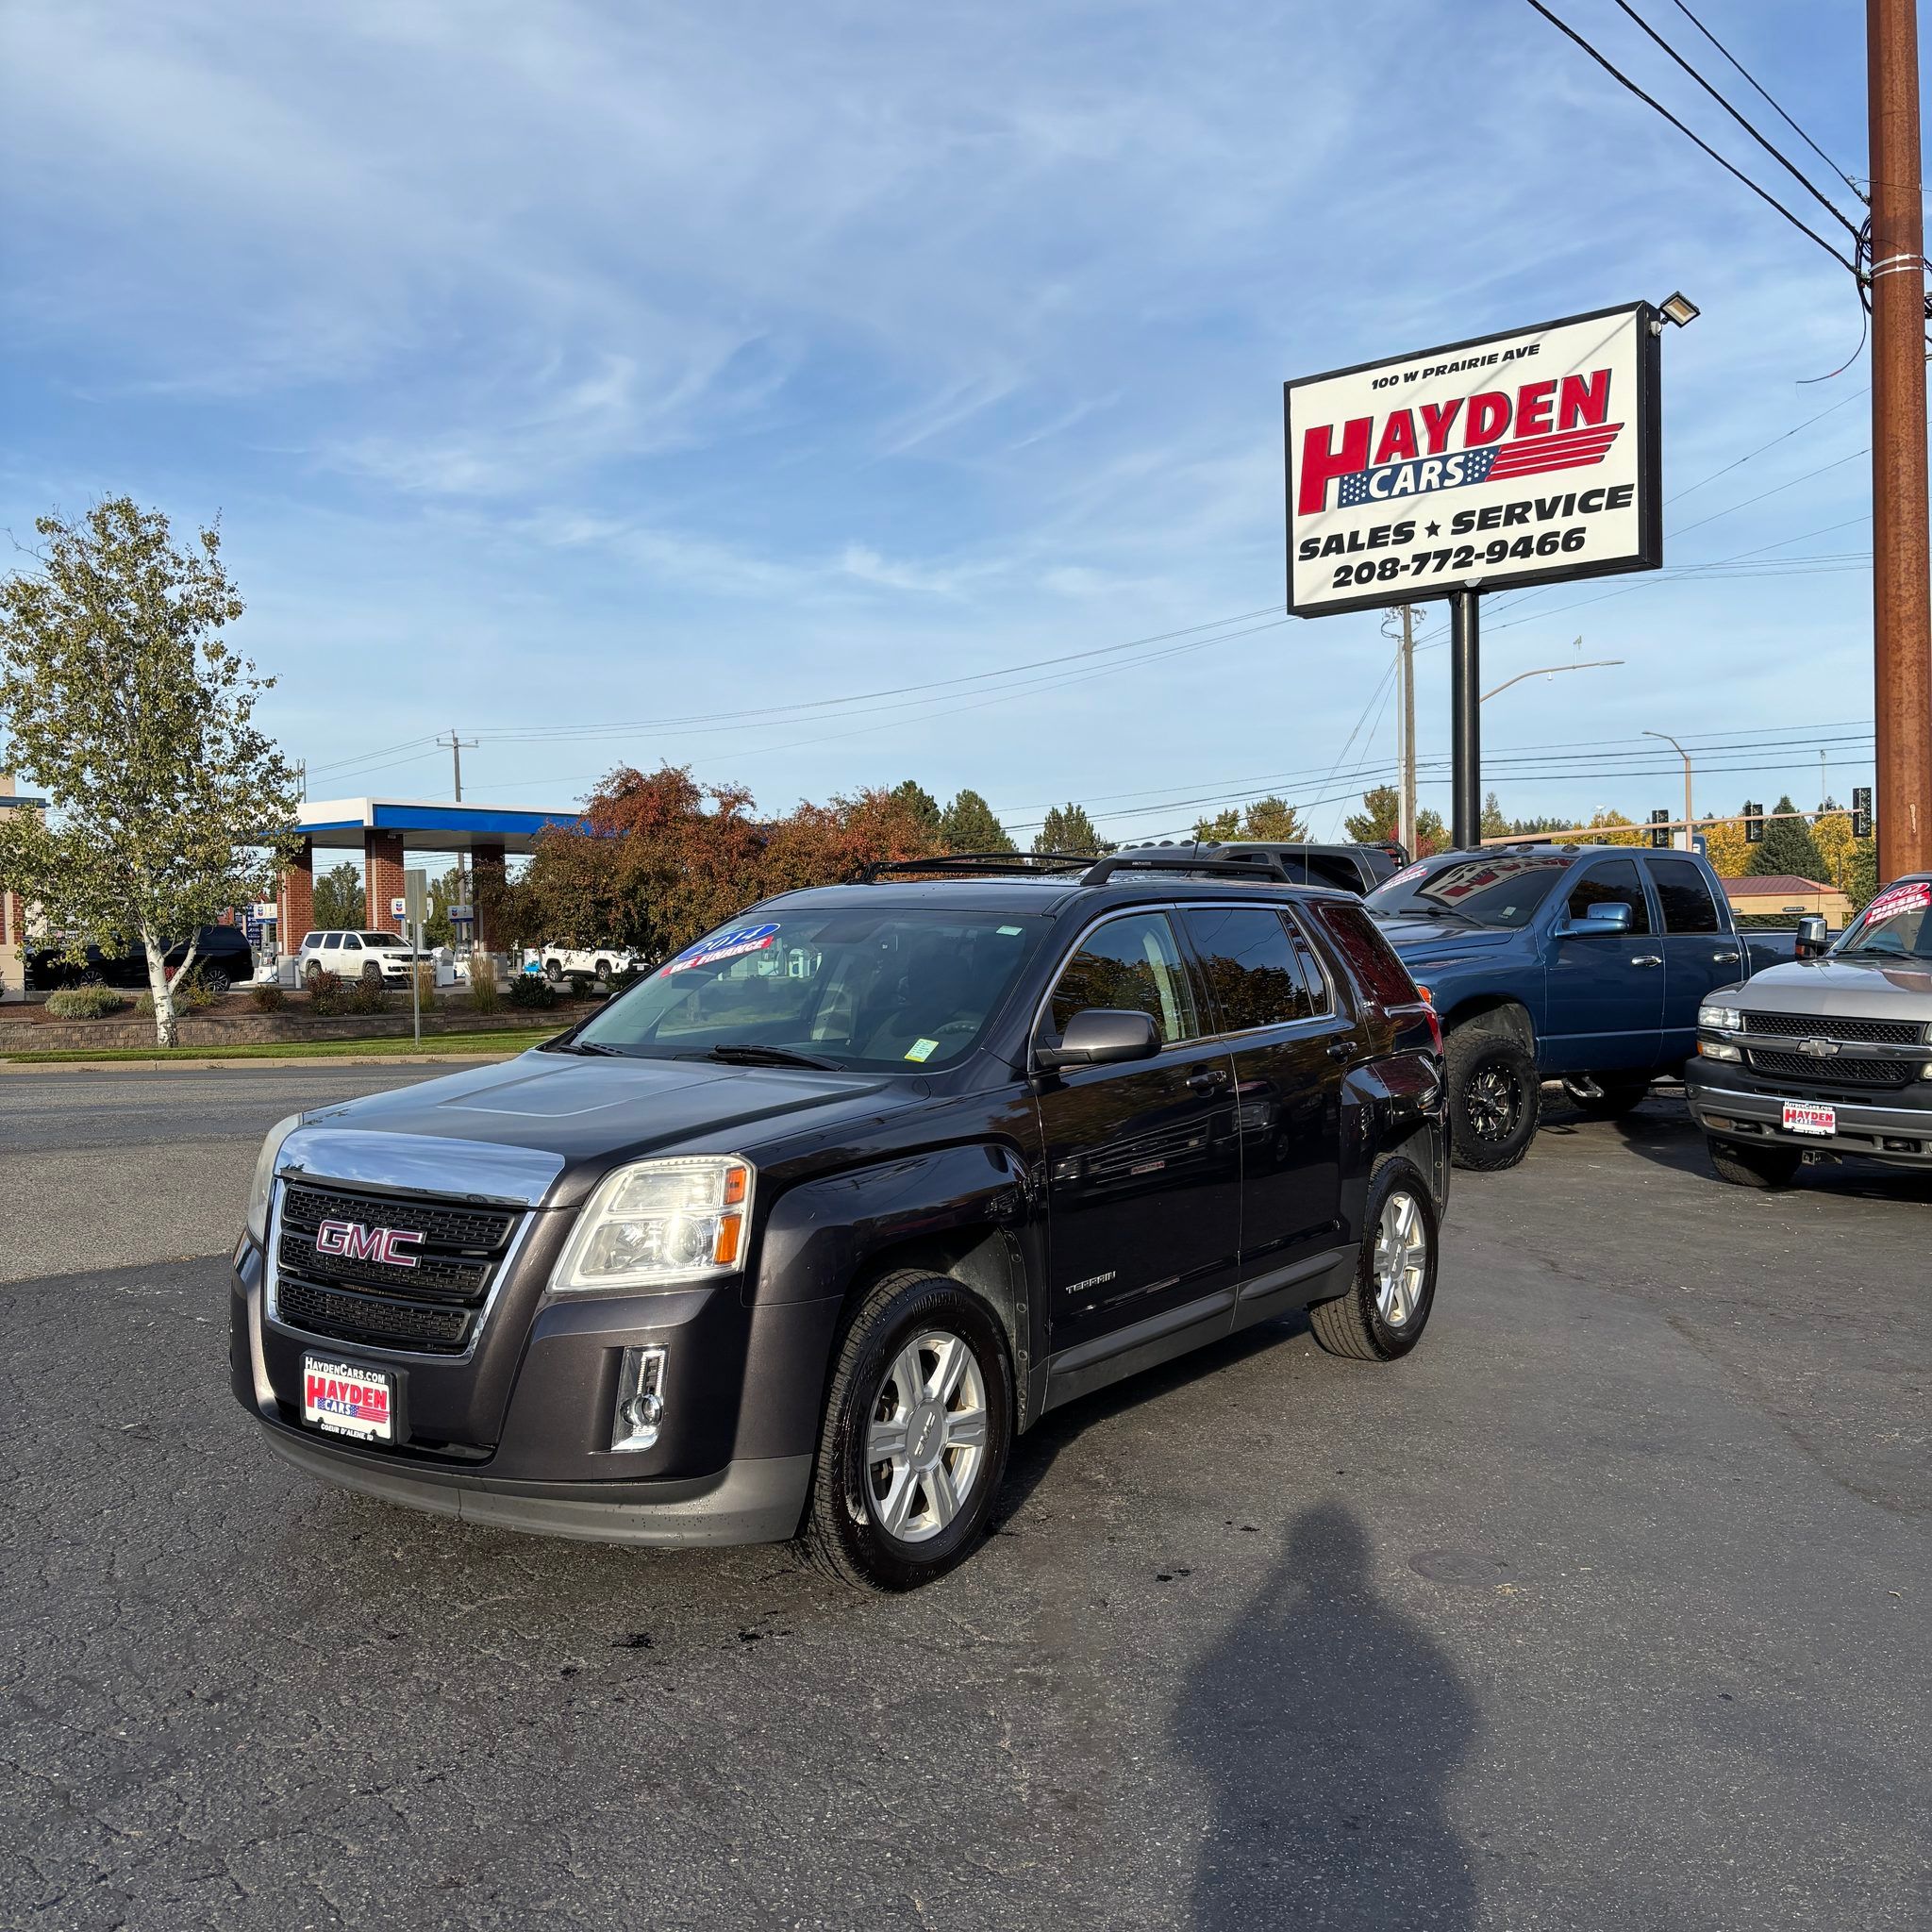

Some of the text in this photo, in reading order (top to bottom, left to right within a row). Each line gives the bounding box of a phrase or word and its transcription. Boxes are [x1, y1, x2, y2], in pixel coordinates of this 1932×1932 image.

[1372, 344, 1541, 390] 100 W PRAIRIE AVE
[1298, 368, 1613, 516] HAYDEN
[1368, 455, 1465, 500] CARS
[1298, 483, 1635, 561] SALES SERVICE
[1332, 526, 1587, 590] 208-772-9466
[1867, 898, 1929, 924] LEATHER
[1872, 893, 1925, 916] DIESEL
[670, 938, 768, 974] WE FINANCE
[689, 925, 766, 958] 2014
[1785, 1109, 1833, 1123] HAYDEN
[316, 1220, 426, 1268] GMC
[1065, 1271, 1116, 1294] TERRAIN
[307, 1374, 388, 1409] HAYDEN
[325, 1400, 352, 1415] CARS
[321, 1423, 340, 1434] COEUR
